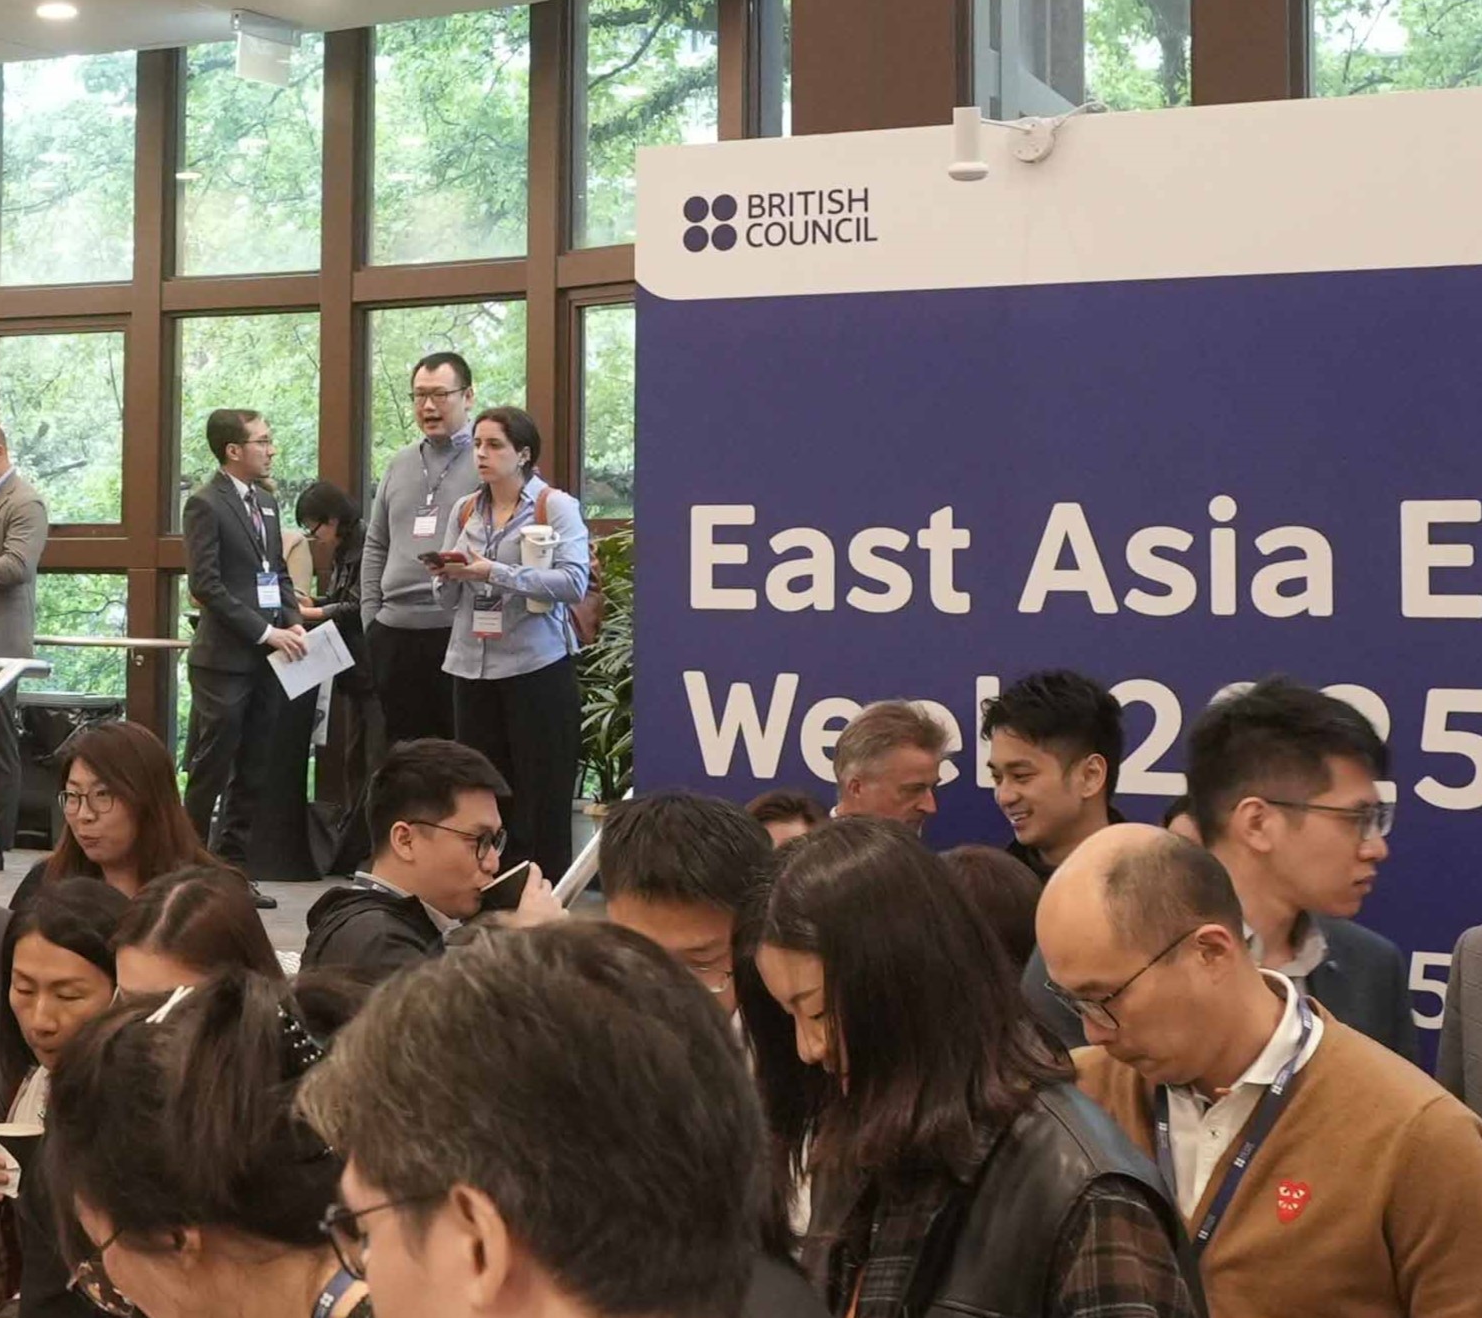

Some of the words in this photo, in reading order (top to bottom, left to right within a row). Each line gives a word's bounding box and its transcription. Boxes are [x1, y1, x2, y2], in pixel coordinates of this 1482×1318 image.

[746, 187, 870, 219] BRITISH
[745, 215, 878, 248] COUNCIL
[689, 504, 972, 615] East
[1018, 494, 1335, 618] Asia
